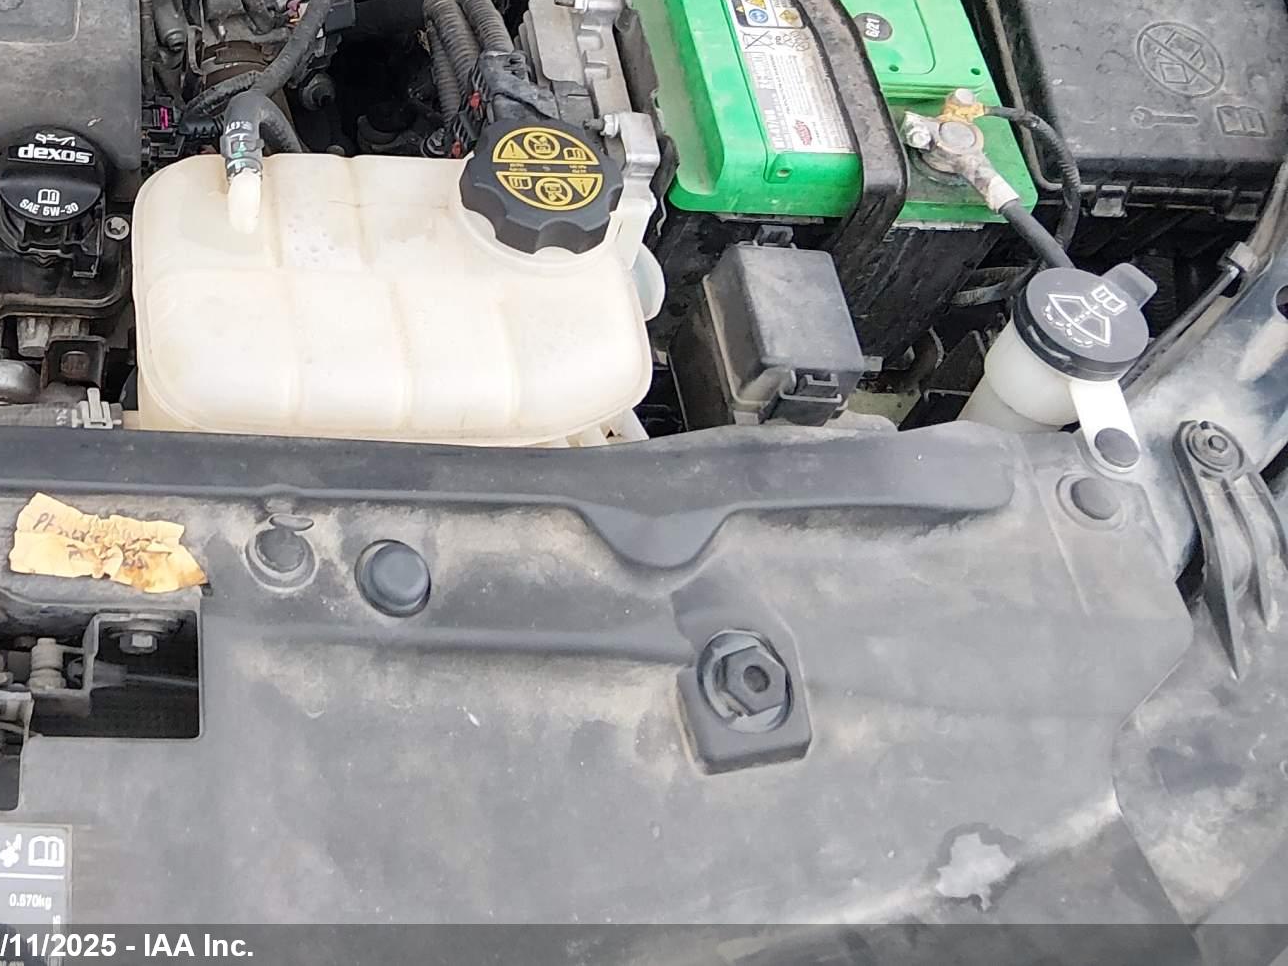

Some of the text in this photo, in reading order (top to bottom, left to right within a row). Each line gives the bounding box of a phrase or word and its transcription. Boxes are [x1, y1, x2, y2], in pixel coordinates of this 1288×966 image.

[865, 18, 881, 38] 6/21
[18, 144, 93, 164] dexos
[19, 199, 79, 217] SAE 5W-30
